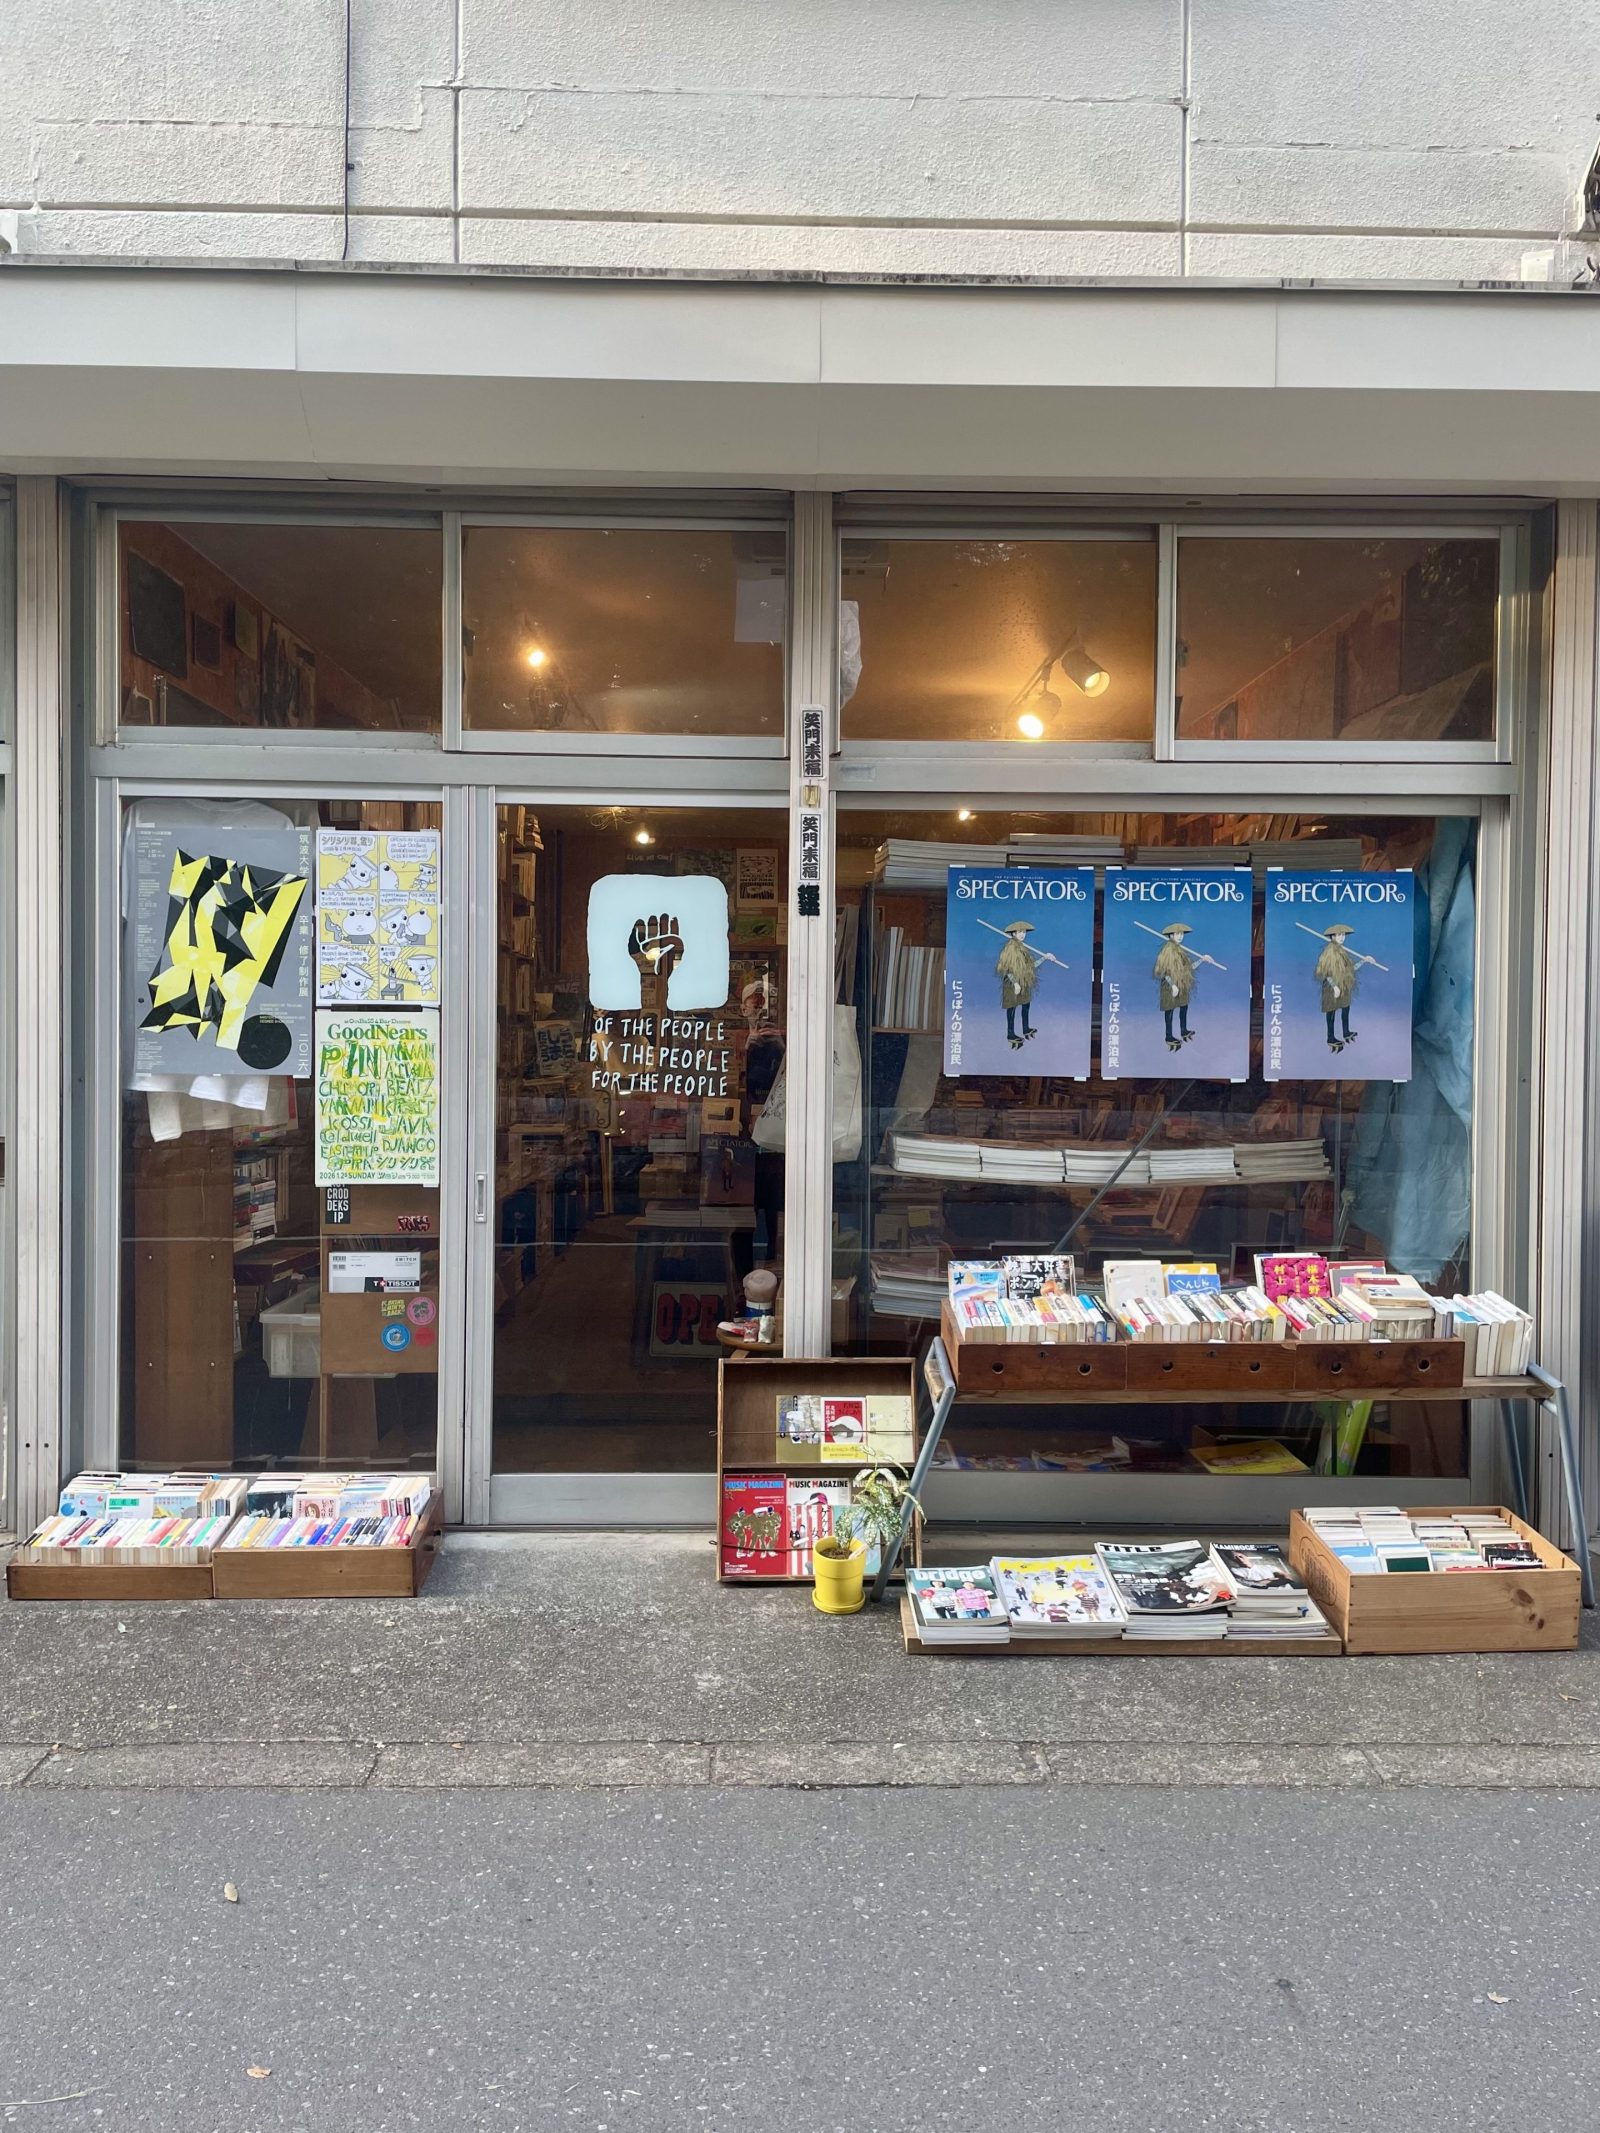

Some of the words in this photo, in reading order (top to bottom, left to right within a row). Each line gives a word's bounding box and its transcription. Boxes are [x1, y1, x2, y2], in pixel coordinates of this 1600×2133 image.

[956, 879, 1087, 901] SPECTATOR
[1113, 881, 1244, 902] SPECTATOR
[1274, 883, 1406, 903] SPECTATOR
[595, 1017, 613, 1035] OF
[621, 1018, 653, 1036] THE
[661, 1018, 725, 1041] PEOPLE
[950, 980, 963, 1065] にっぽんの漂泊民
[1108, 983, 1120, 1068] にっぽんの漂泊民
[1270, 984, 1282, 1070] にっぽんの漂泊民
[327, 1023, 428, 1040] GoodNears
[590, 1041, 614, 1062] BY
[620, 1043, 655, 1066] THE
[659, 1047, 729, 1072] PEOPLE
[591, 1070, 621, 1091] FOR
[628, 1073, 659, 1093] THE
[663, 1074, 728, 1097] PEOPLE
[382, 1138, 436, 1153] DJANGO
[348, 1172, 375, 1180] SUNDAY
[327, 1188, 349, 1199] CROD
[327, 1200, 349, 1211] DEKS
[333, 1212, 344, 1223] IP
[1175, 1278, 1210, 1289] へんしん
[656, 1293, 726, 1345] OPE
[724, 1481, 747, 1489] MUSIC
[748, 1481, 784, 1489] MAGAZINE
[789, 1480, 811, 1488] MUSIC
[812, 1480, 849, 1488] MAGAZINE
[1100, 1544, 1162, 1552] TITLE
[1213, 1543, 1258, 1551] KAMINOGE
[914, 1568, 986, 1583] bridge
